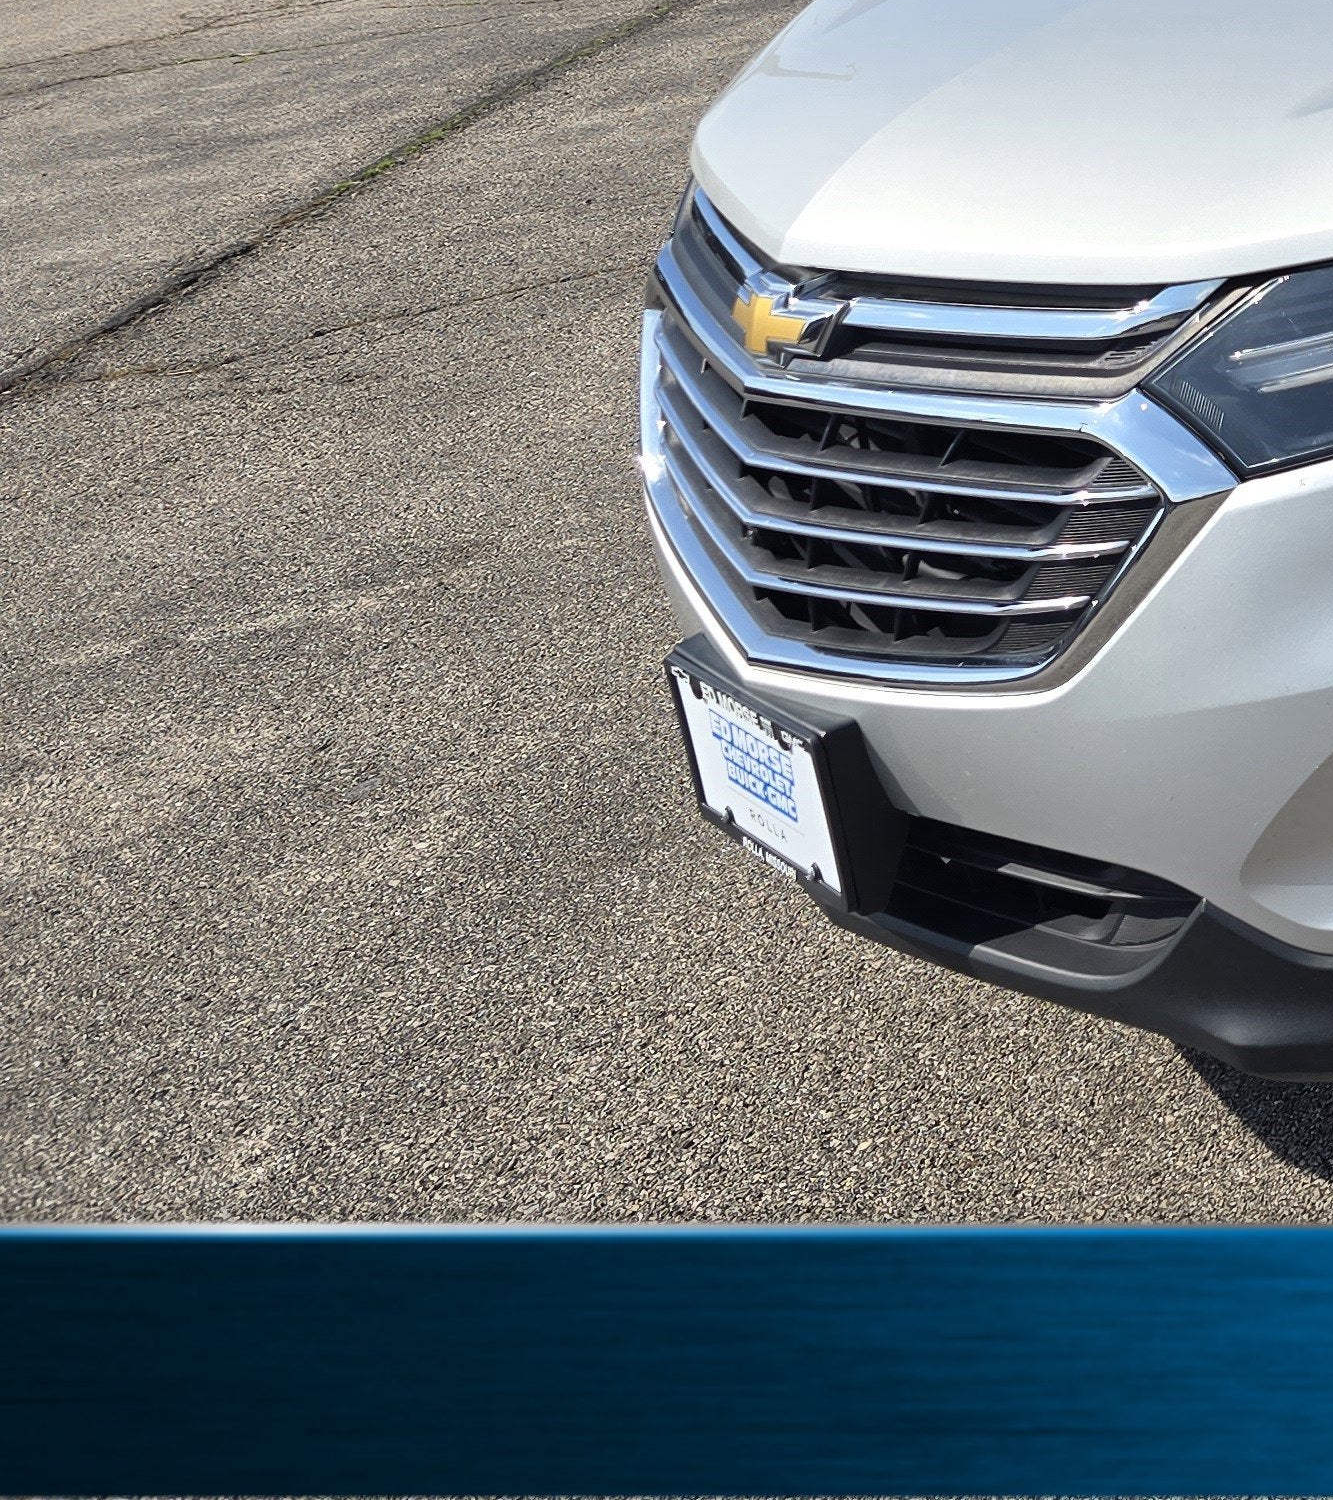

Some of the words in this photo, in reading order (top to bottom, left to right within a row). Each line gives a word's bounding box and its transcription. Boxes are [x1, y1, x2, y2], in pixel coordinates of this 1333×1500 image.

[710, 711, 733, 744] ED
[731, 723, 794, 785] MORSE
[721, 738, 794, 798] CHEVROLET
[727, 761, 766, 801] BUICK
[766, 785, 798, 822] GMC
[748, 808, 788, 844] ROLLA
